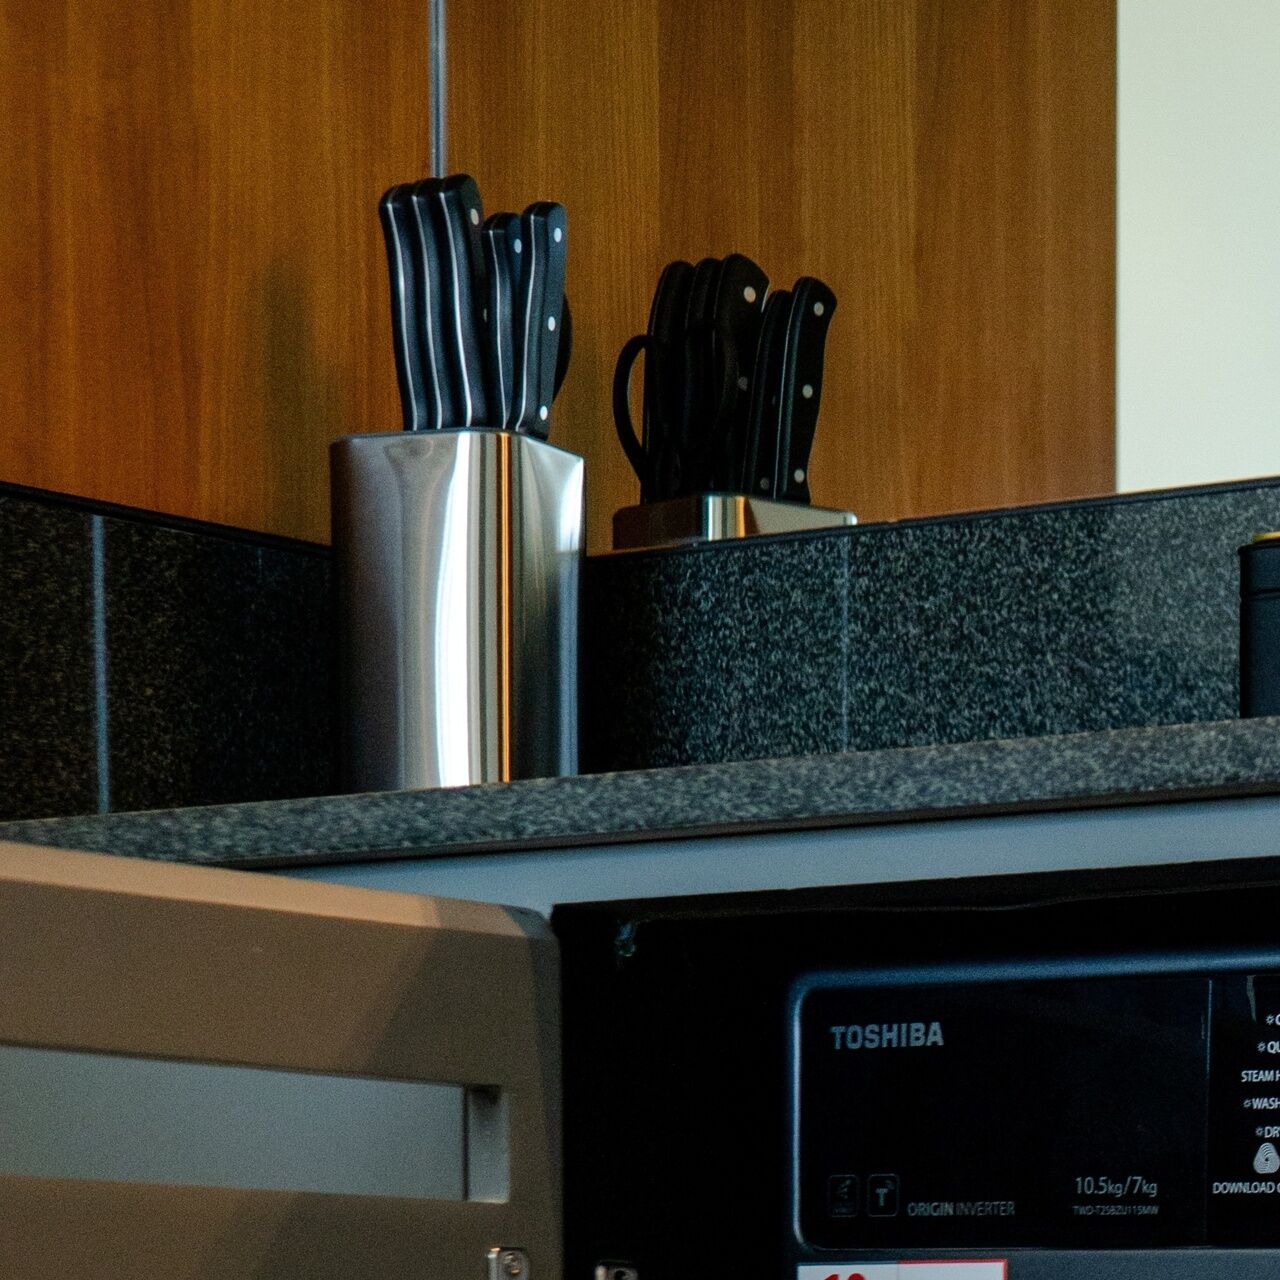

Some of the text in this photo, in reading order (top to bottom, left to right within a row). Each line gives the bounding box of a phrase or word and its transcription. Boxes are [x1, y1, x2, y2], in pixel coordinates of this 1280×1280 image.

[832, 1022, 944, 1049] TOSHIBA
[1241, 1069, 1275, 1083] STEAM
[1075, 1176, 1158, 1198] 10.5kg/7kg
[1212, 1181, 1276, 1195] DOWNLOAD
[907, 1200, 1016, 1217] ORIGIN INVERTER
